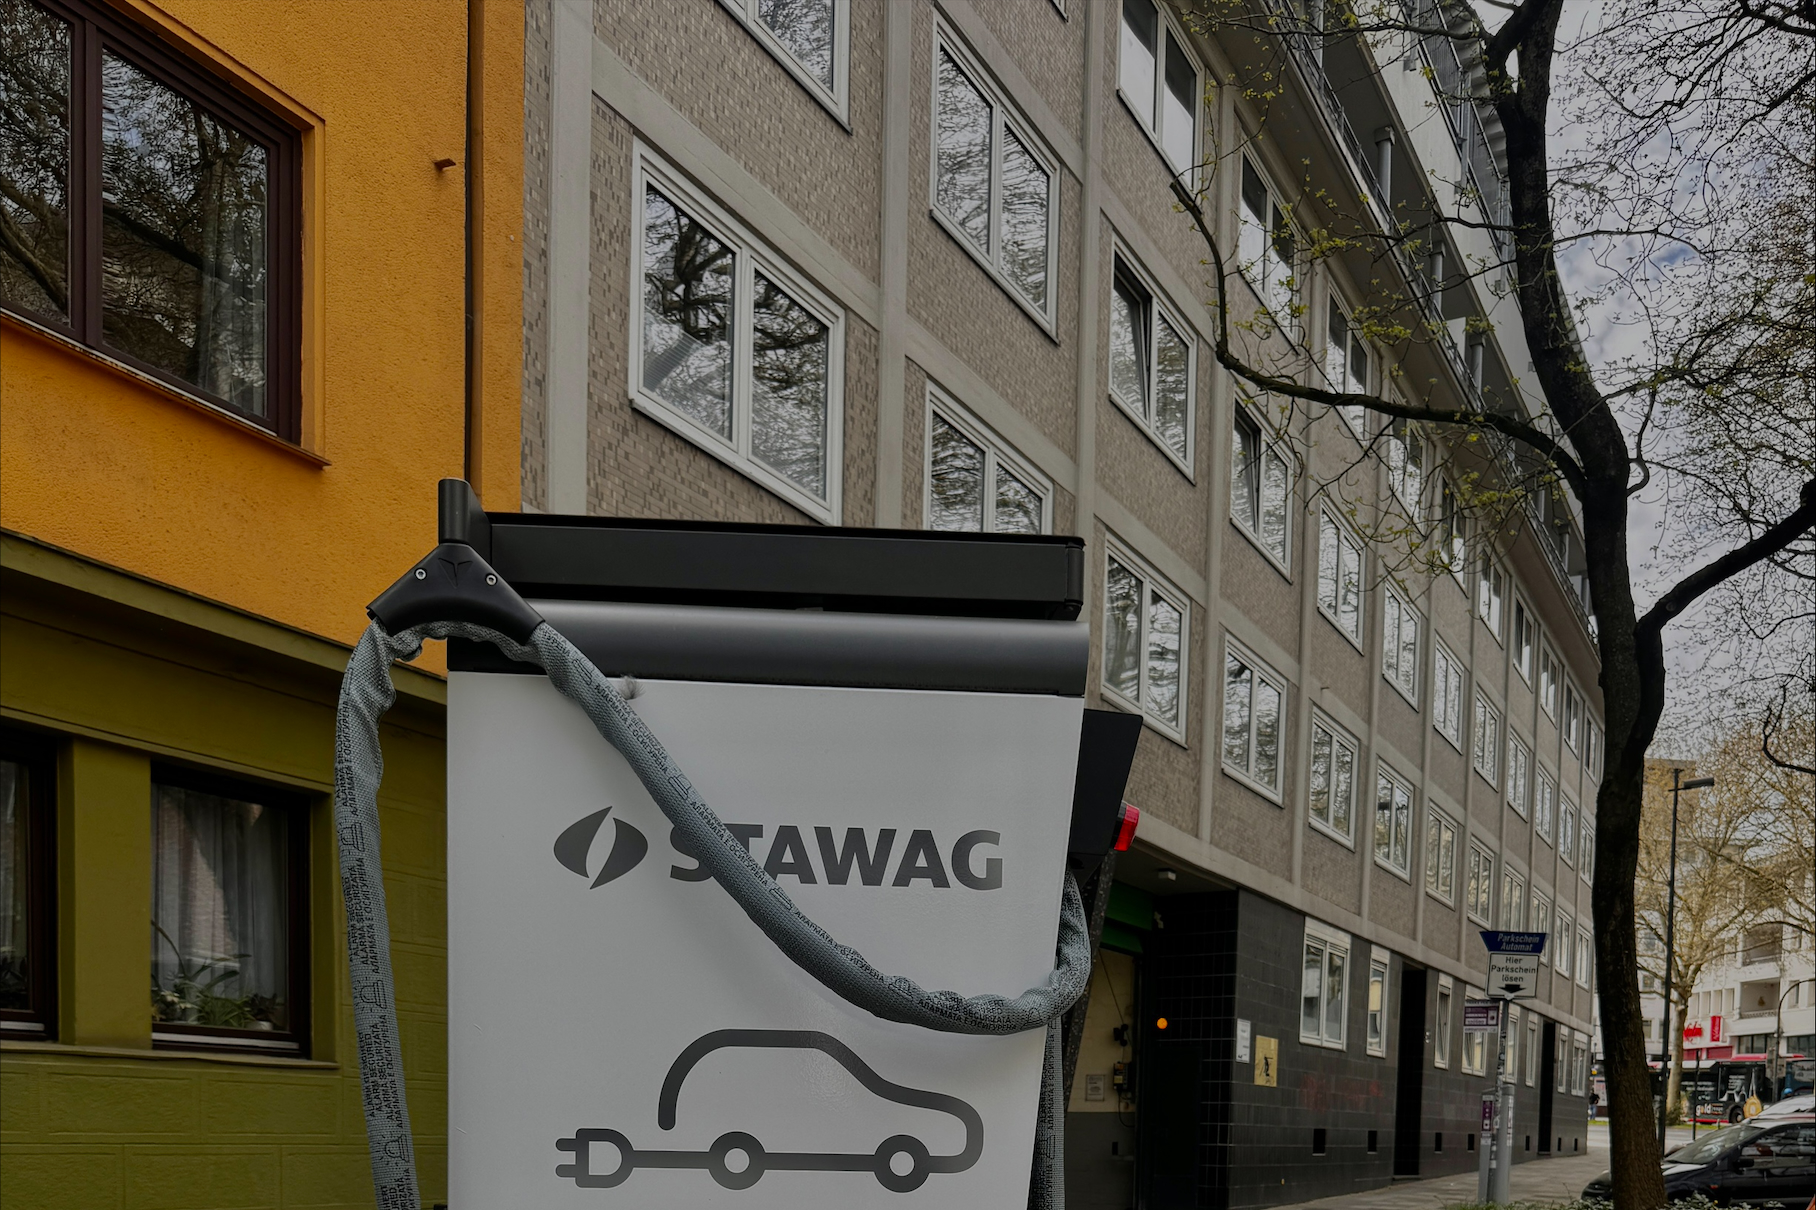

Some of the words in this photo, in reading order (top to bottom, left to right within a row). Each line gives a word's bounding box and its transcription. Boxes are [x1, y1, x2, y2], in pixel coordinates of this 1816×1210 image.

[1497, 933, 1539, 944] Parkschein
[1500, 942, 1533, 952] Automat
[1505, 956, 1523, 964] Hier
[1491, 965, 1536, 974] Parkschein
[1502, 974, 1524, 982] lösen
